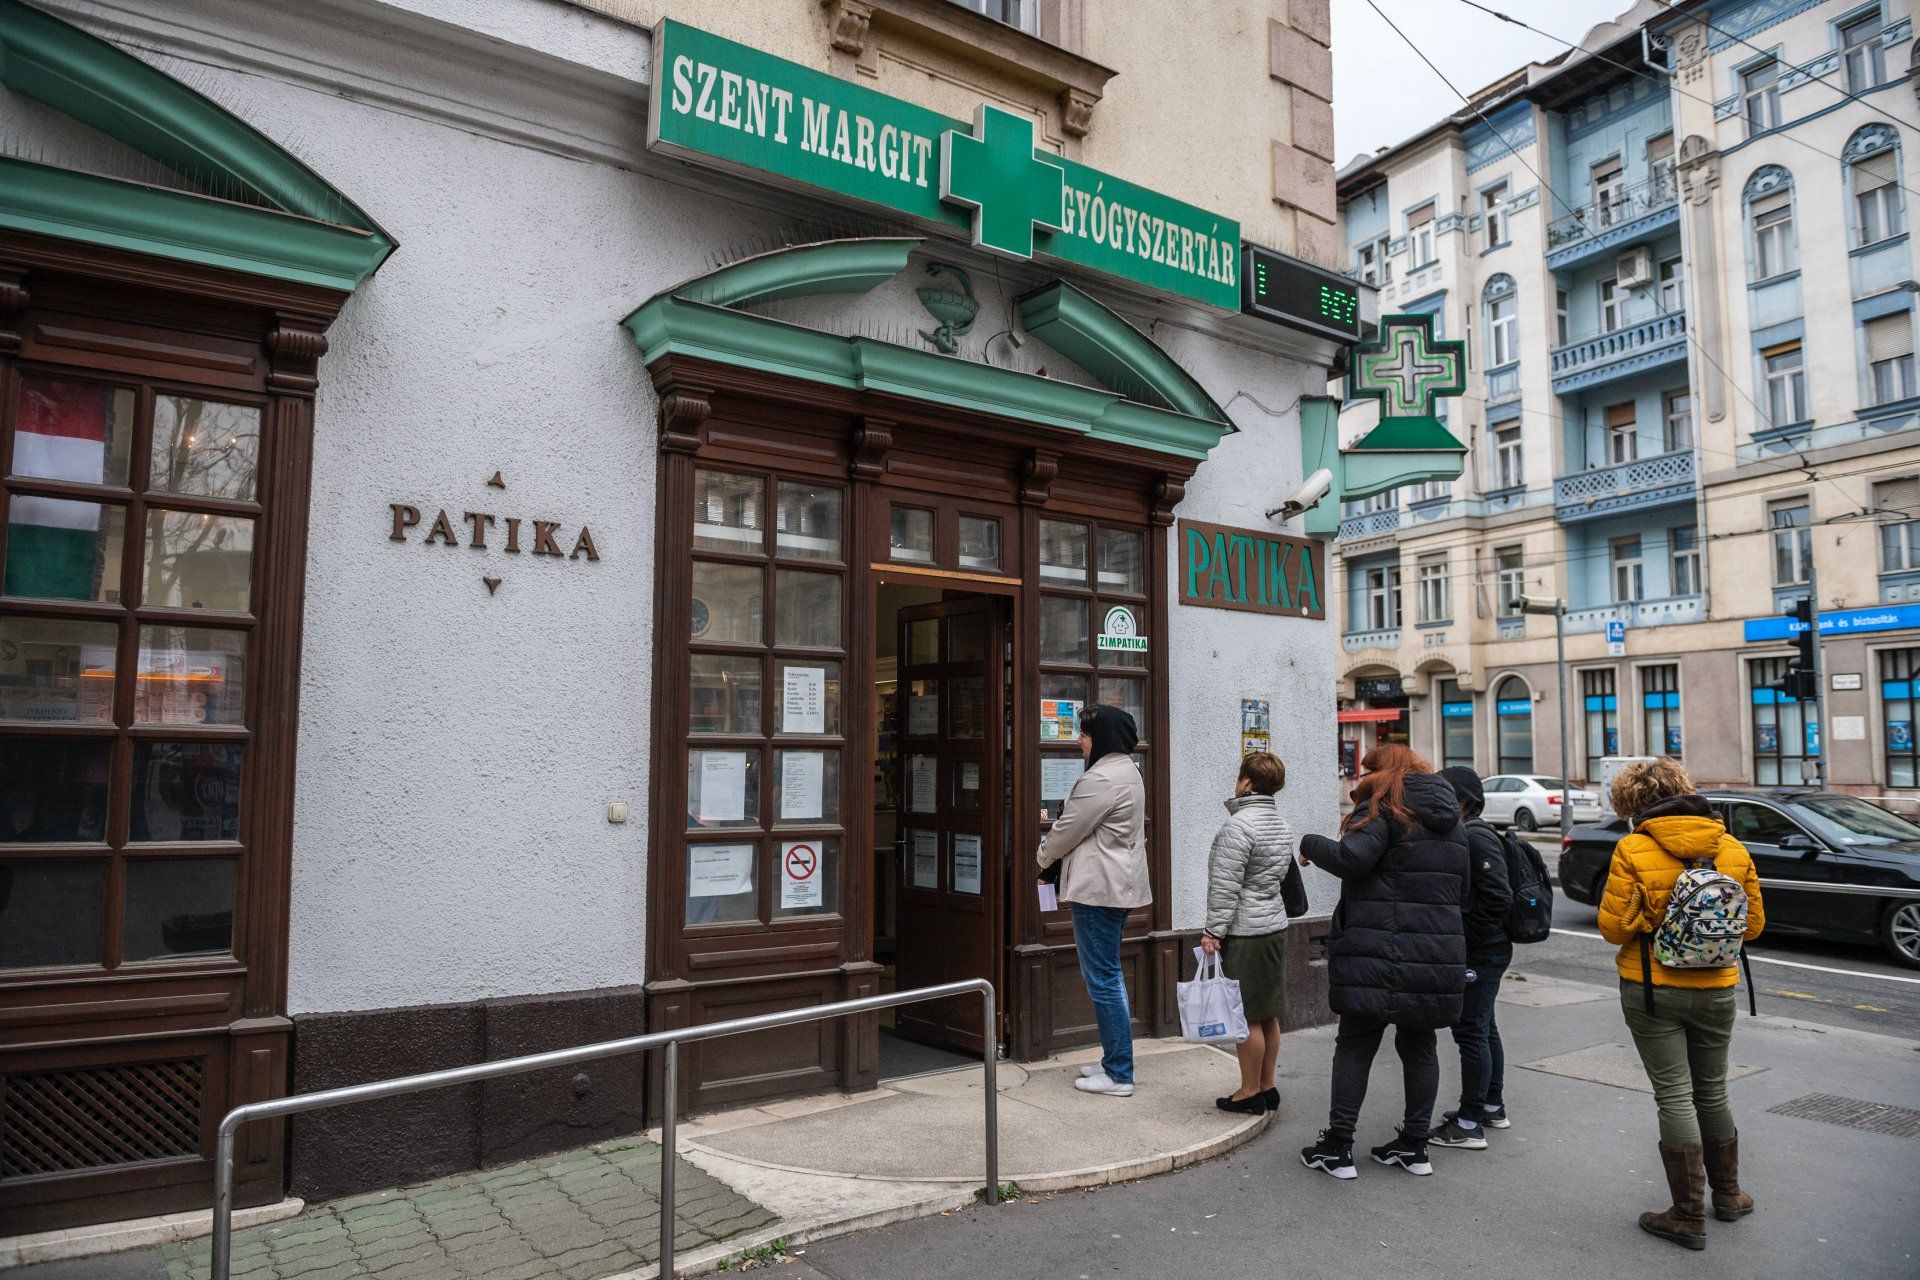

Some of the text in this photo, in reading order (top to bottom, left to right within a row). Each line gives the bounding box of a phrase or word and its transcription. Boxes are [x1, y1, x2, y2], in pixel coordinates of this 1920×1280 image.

[672, 54, 1235, 287] SZENT MARGIT GYÓGYSZERTÁR
[389, 503, 600, 561] PATIKA
[1186, 527, 1321, 612] PATIKA
[1097, 636, 1147, 649] ZIMPATIKA
[1819, 620, 1834, 630] ank
[1838, 617, 1849, 628] és
